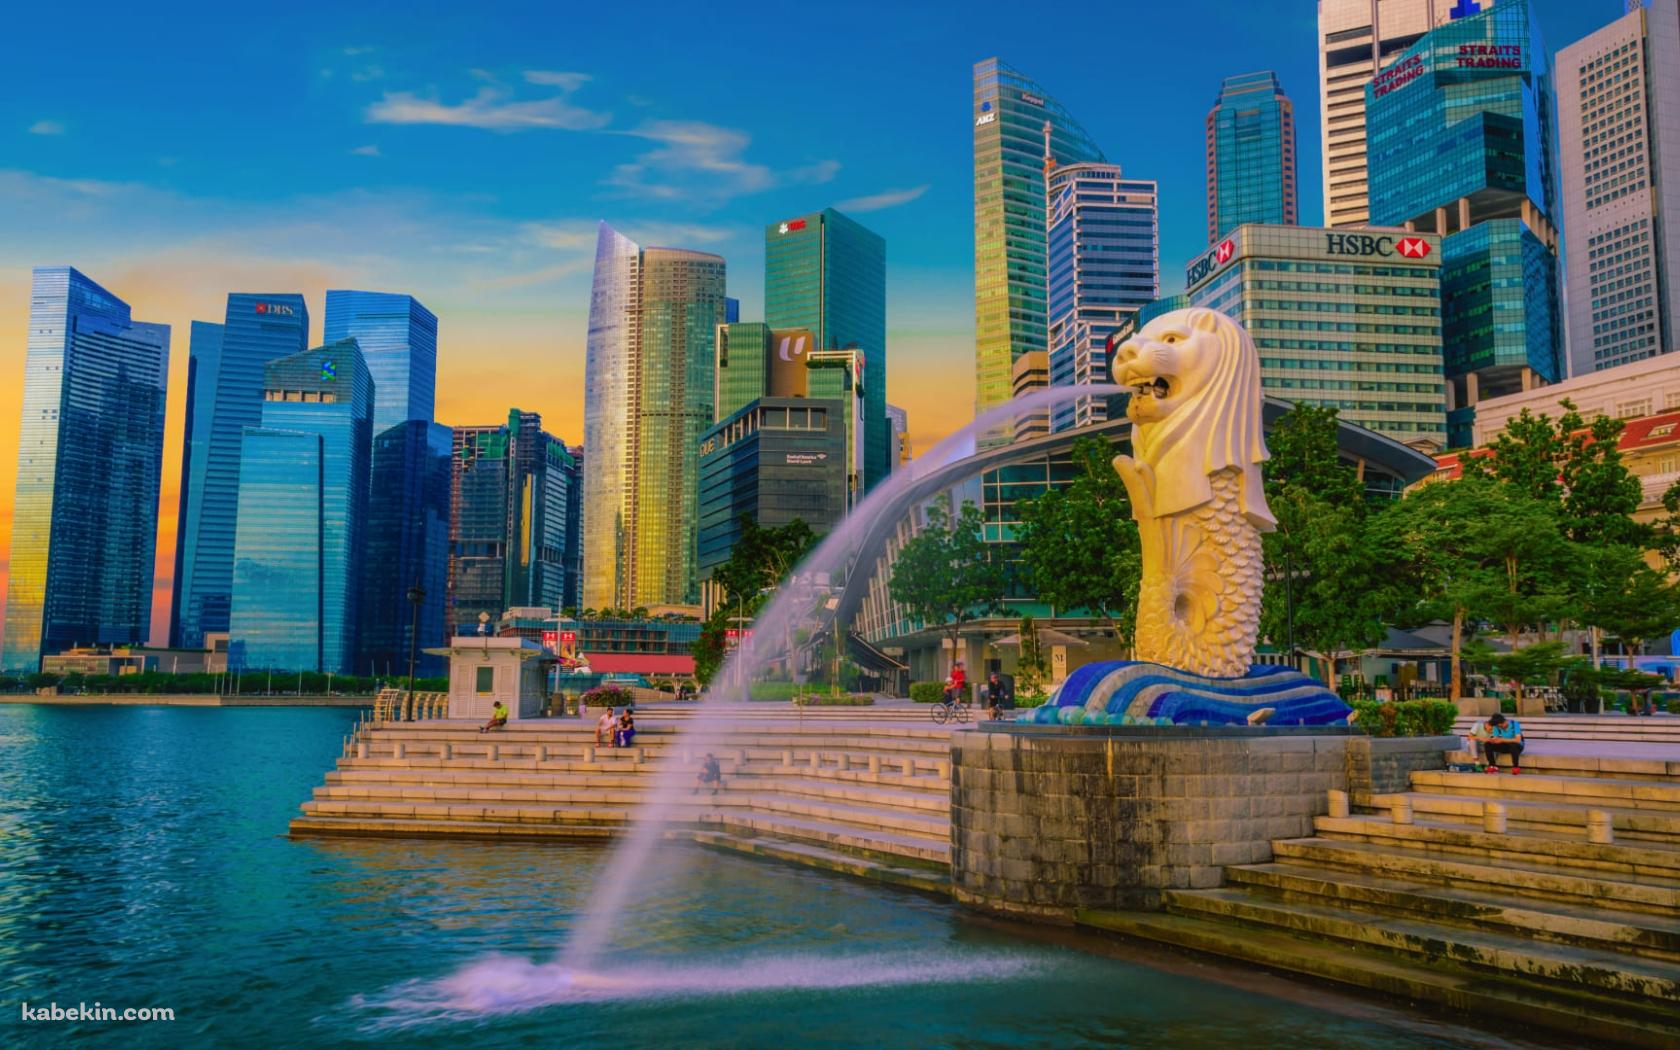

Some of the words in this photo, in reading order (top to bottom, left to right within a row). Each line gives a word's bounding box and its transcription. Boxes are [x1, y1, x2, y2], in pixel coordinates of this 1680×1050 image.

[1459, 45, 1520, 56] STRAITS
[1373, 54, 1420, 87] STRAITS
[1456, 57, 1521, 68] TRADING
[1374, 64, 1424, 98] TRADING
[1326, 233, 1393, 256] HSBC
[1187, 250, 1216, 288] HSBC
[267, 304, 293, 315] DBS
